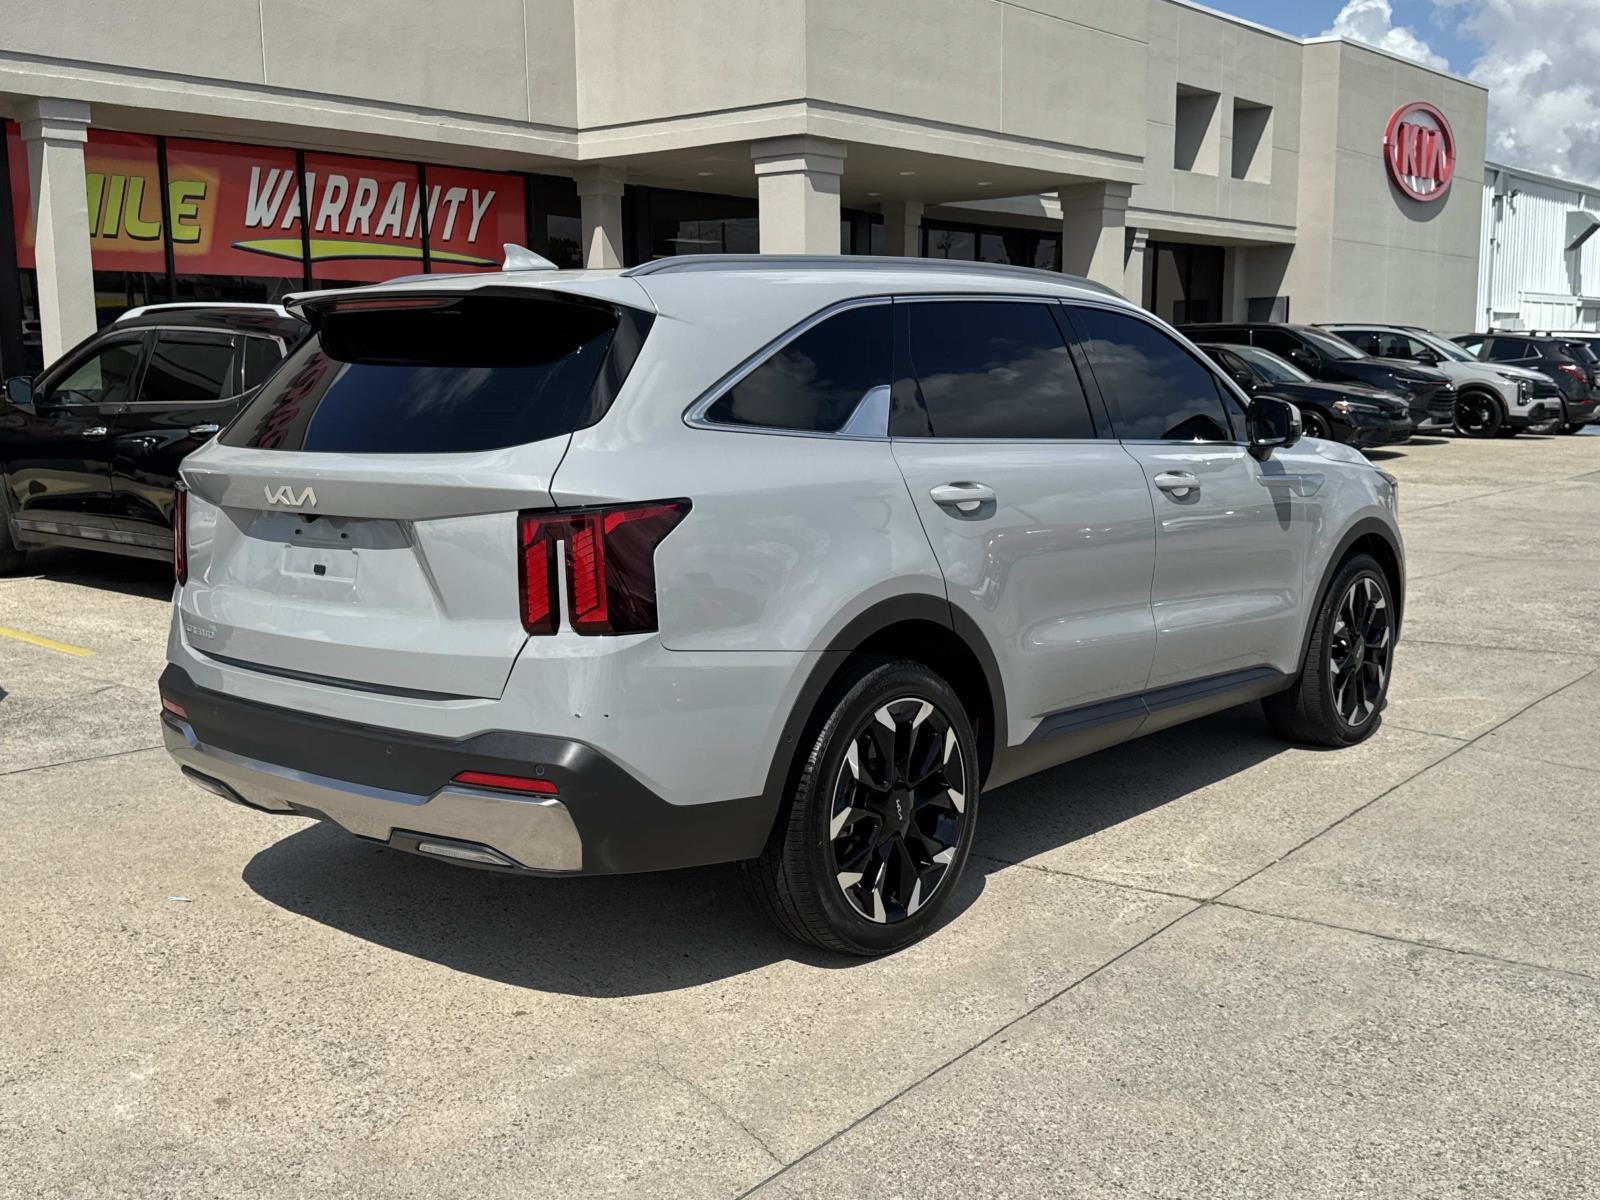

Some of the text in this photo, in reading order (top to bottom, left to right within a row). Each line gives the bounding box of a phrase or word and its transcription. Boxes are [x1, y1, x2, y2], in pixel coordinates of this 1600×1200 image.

[1396, 121, 1444, 184] KIA
[244, 166, 496, 242] WARRANTY
[263, 484, 318, 507] KIA
